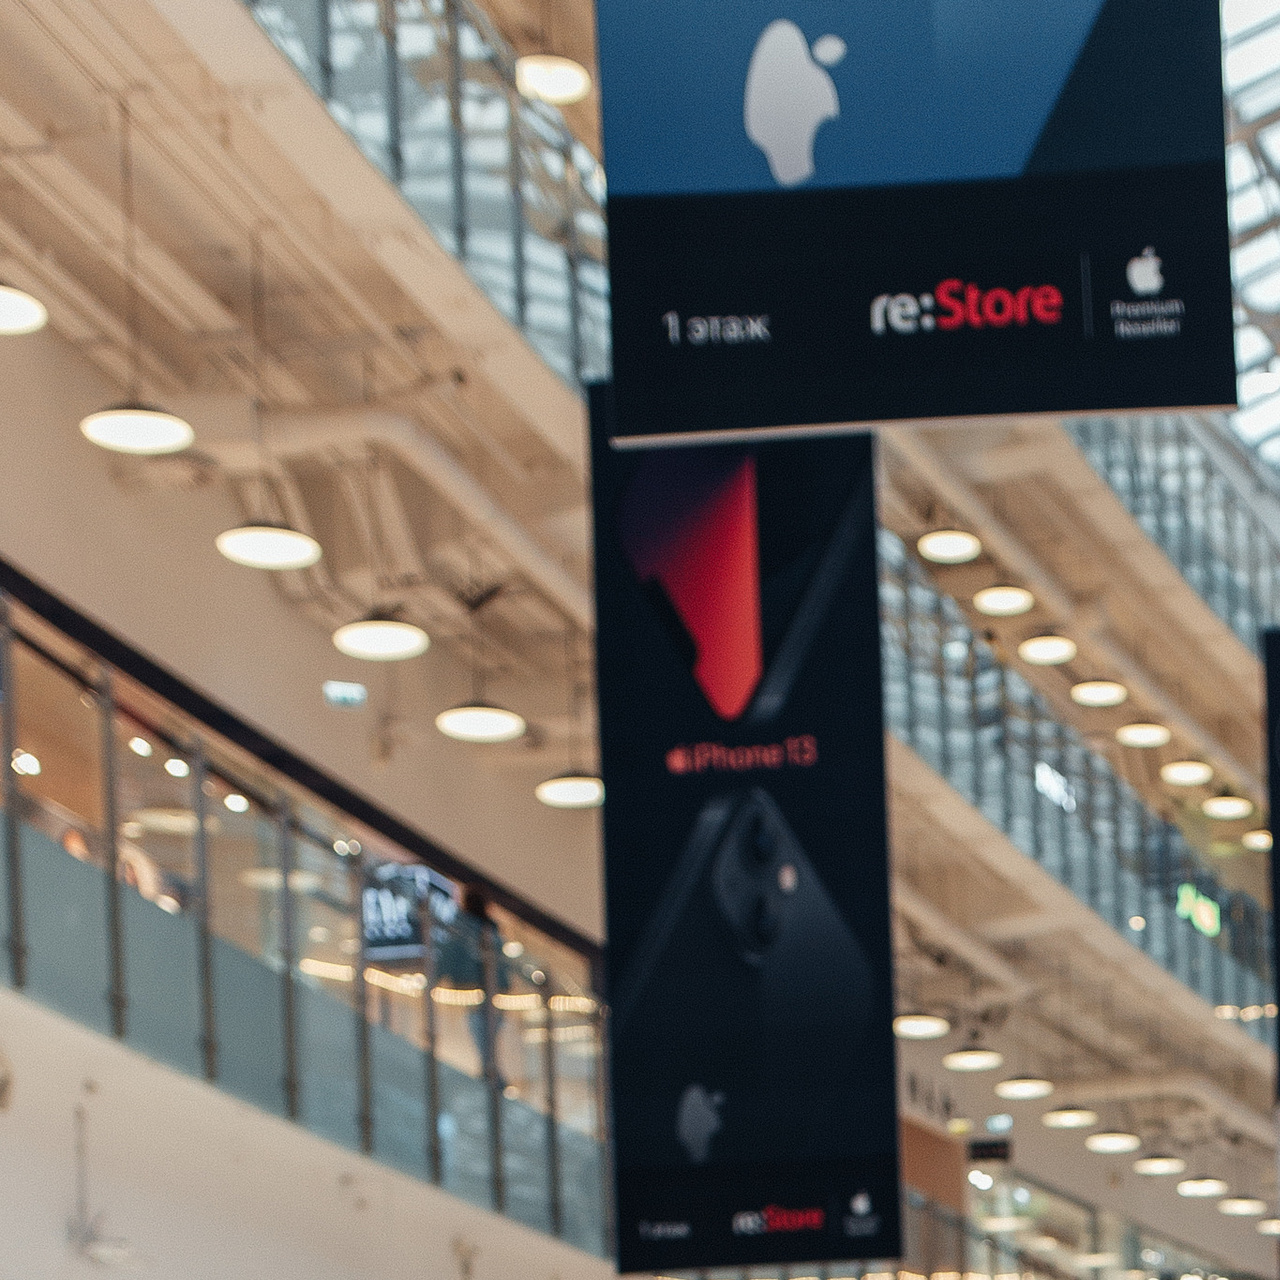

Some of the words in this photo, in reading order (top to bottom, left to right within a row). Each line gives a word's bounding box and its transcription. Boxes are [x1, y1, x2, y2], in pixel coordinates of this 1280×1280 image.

[869, 277, 1064, 335] re:Store
[661, 310, 682, 344] 1
[687, 741, 785, 773] iPhone
[786, 734, 818, 767] 13
